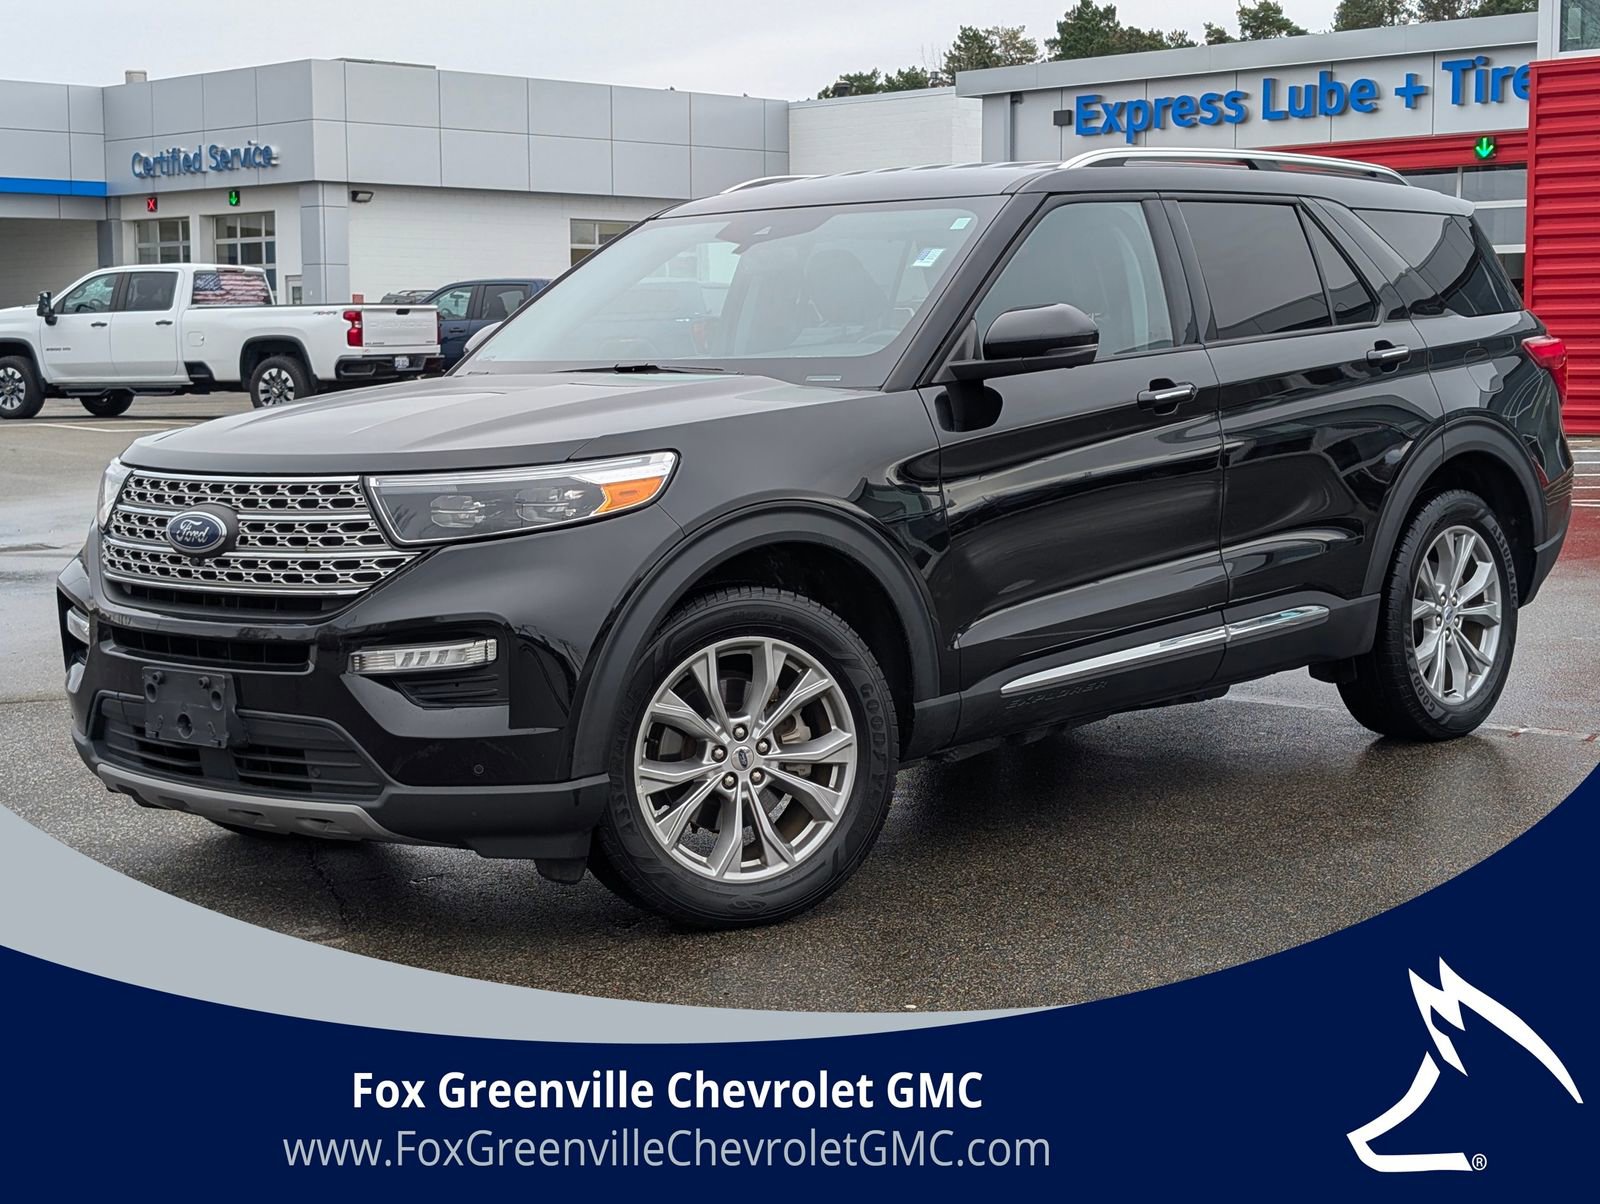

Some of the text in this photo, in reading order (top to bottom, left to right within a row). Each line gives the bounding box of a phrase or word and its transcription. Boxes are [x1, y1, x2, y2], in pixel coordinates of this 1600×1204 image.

[1074, 55, 1529, 145] Express Lube + Tire
[131, 141, 275, 178] Certified Service
[176, 519, 211, 543] Ford
[1404, 624, 1436, 713] GOODYEA
[1004, 680, 1109, 710] EXPLORER
